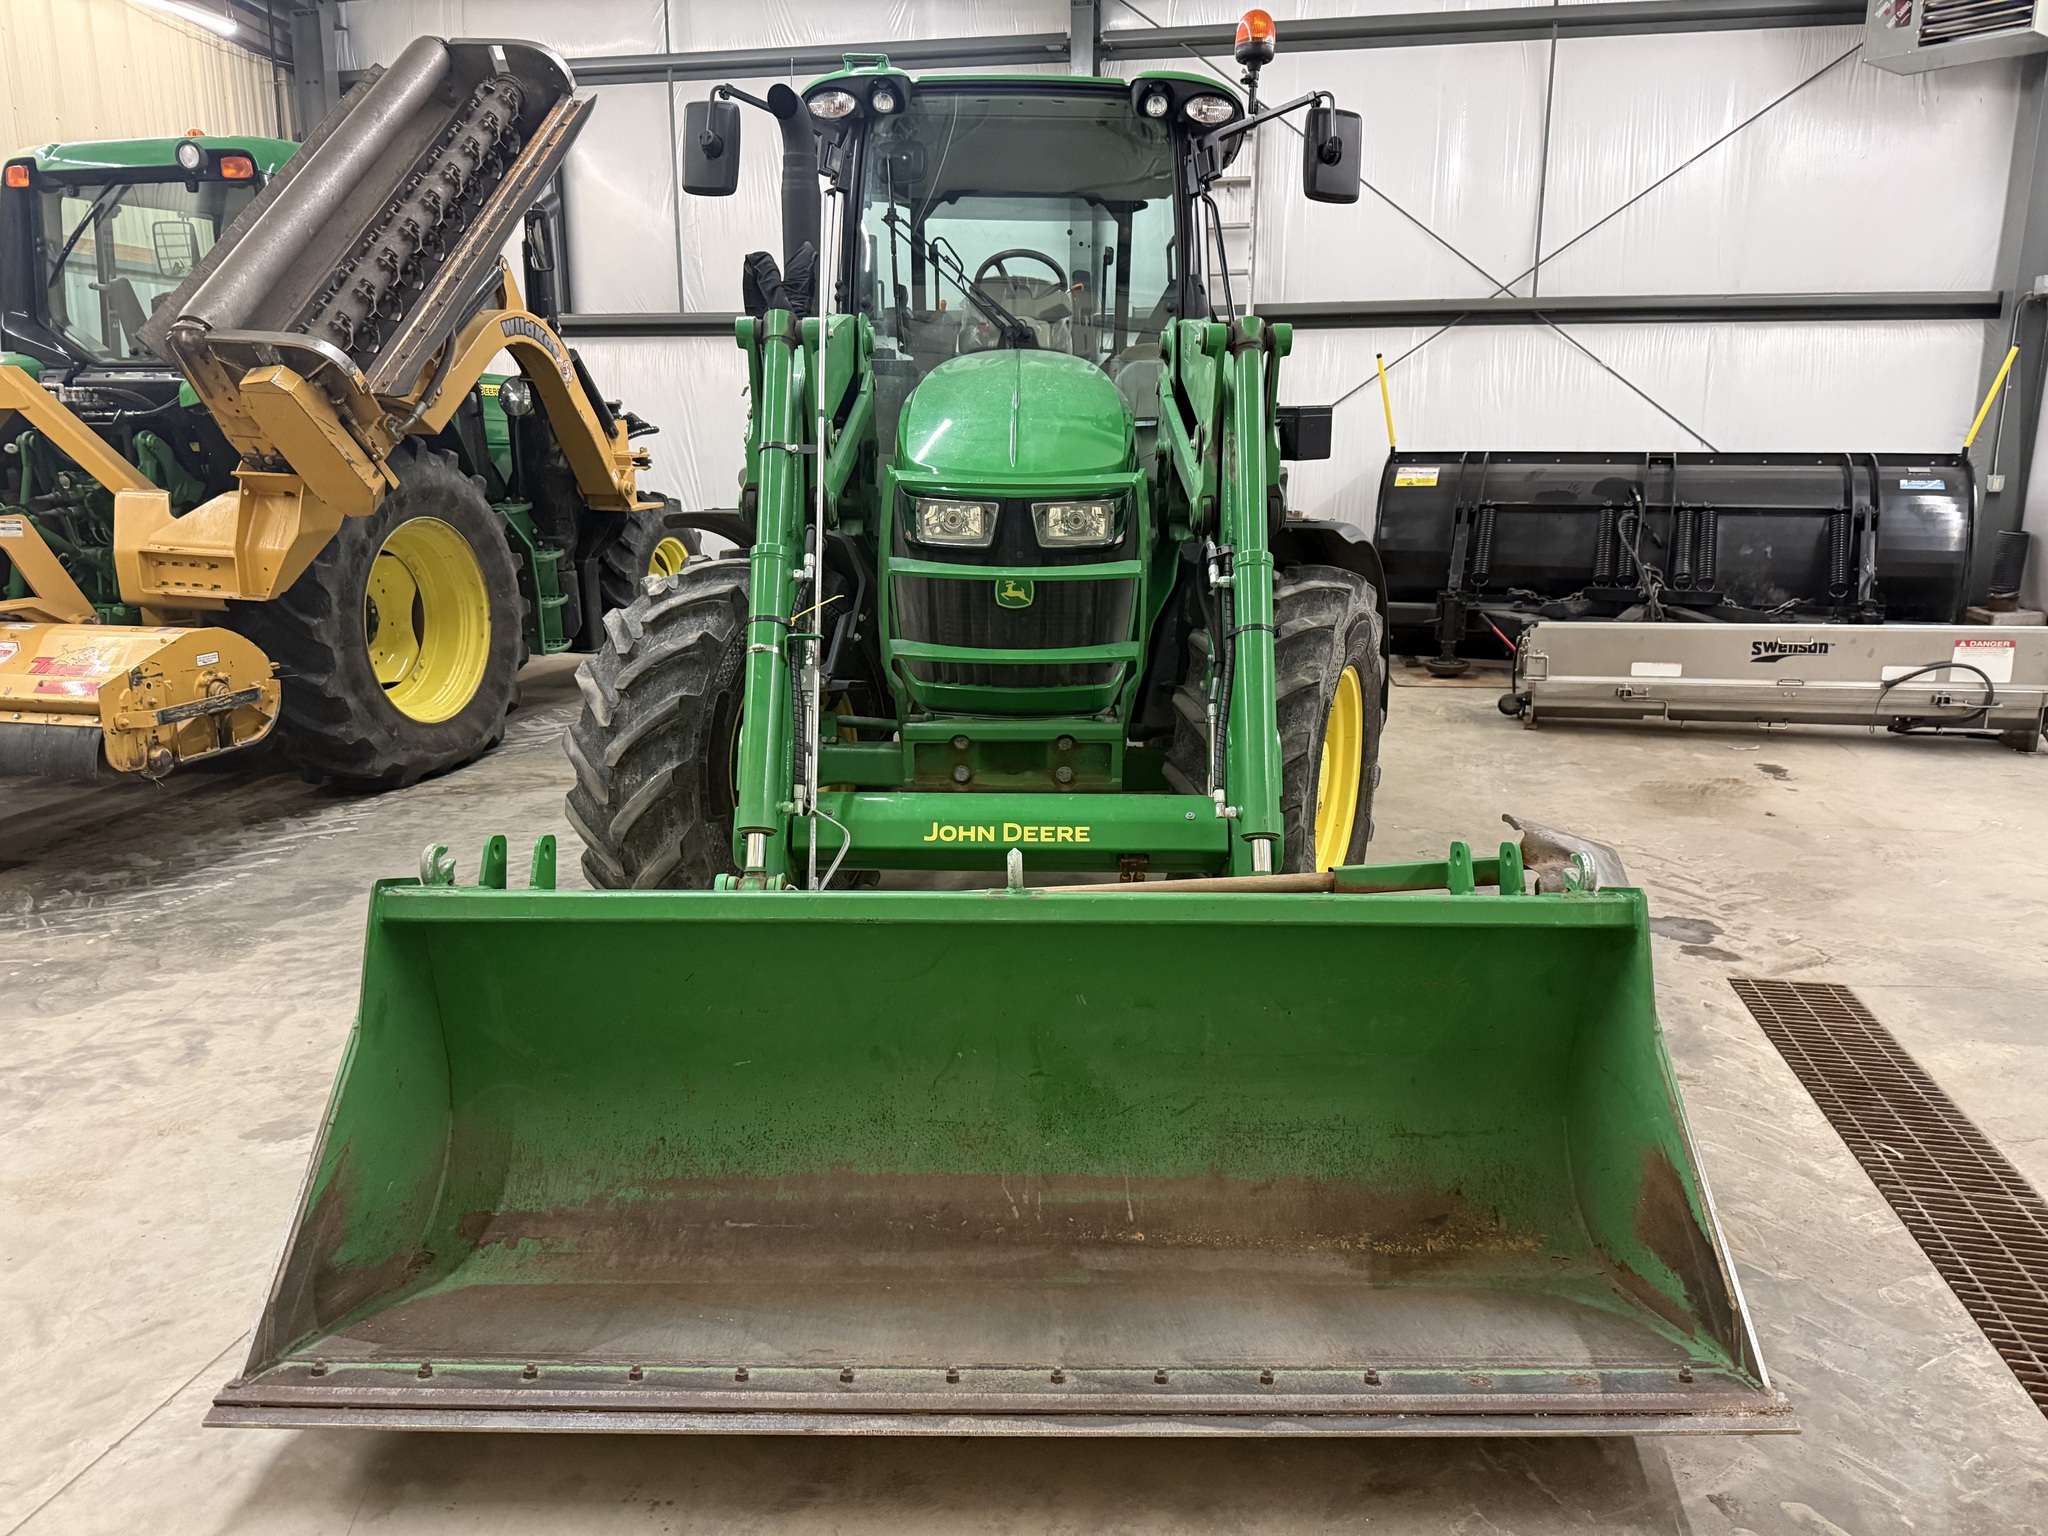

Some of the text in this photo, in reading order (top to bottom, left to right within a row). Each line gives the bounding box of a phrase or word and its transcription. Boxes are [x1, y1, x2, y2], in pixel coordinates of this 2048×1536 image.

[1886, 15, 1899, 29] HOT
[1970, 640, 2011, 648] DANGER
[923, 822, 1091, 843] JOHN DEERE
